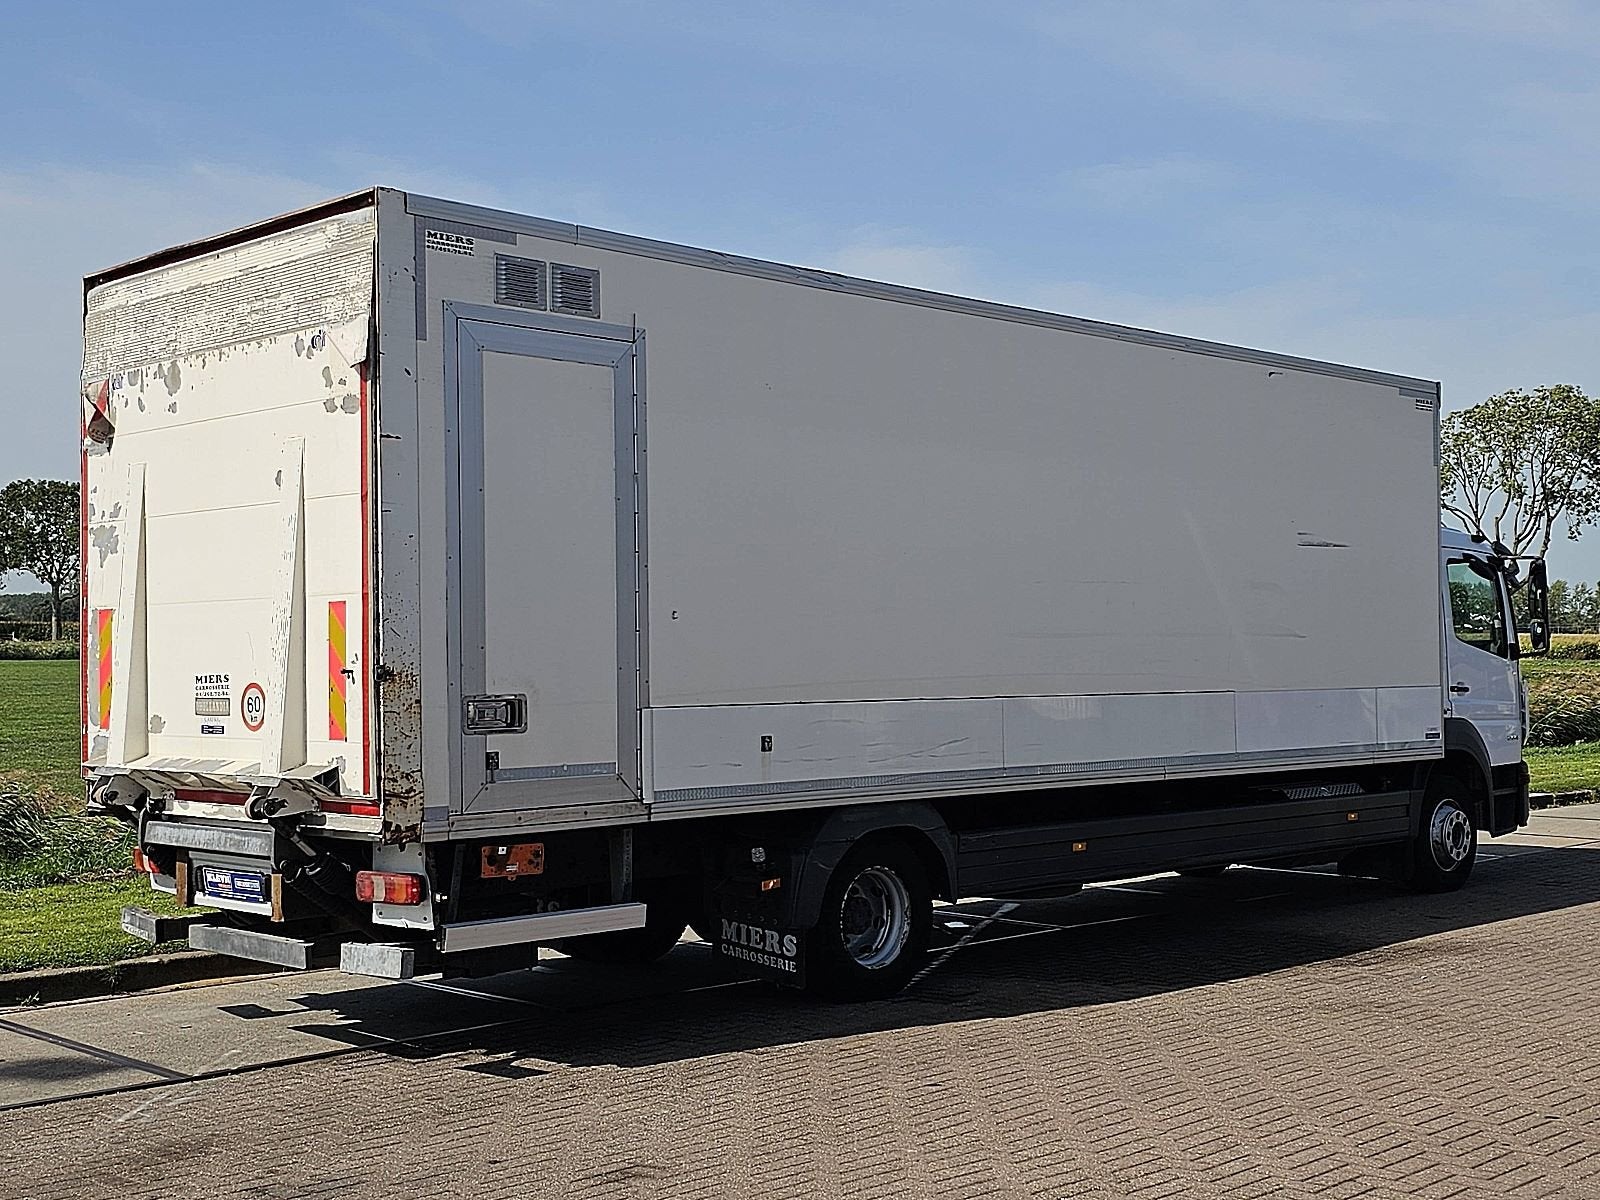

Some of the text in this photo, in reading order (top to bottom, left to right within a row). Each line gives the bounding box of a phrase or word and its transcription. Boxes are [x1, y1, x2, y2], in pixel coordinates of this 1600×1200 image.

[426, 230, 474, 245] MIERS
[195, 674, 230, 685] MIERS
[247, 696, 260, 713] 60
[721, 918, 797, 957] MIERS
[721, 943, 797, 973] CARROSSERIE
